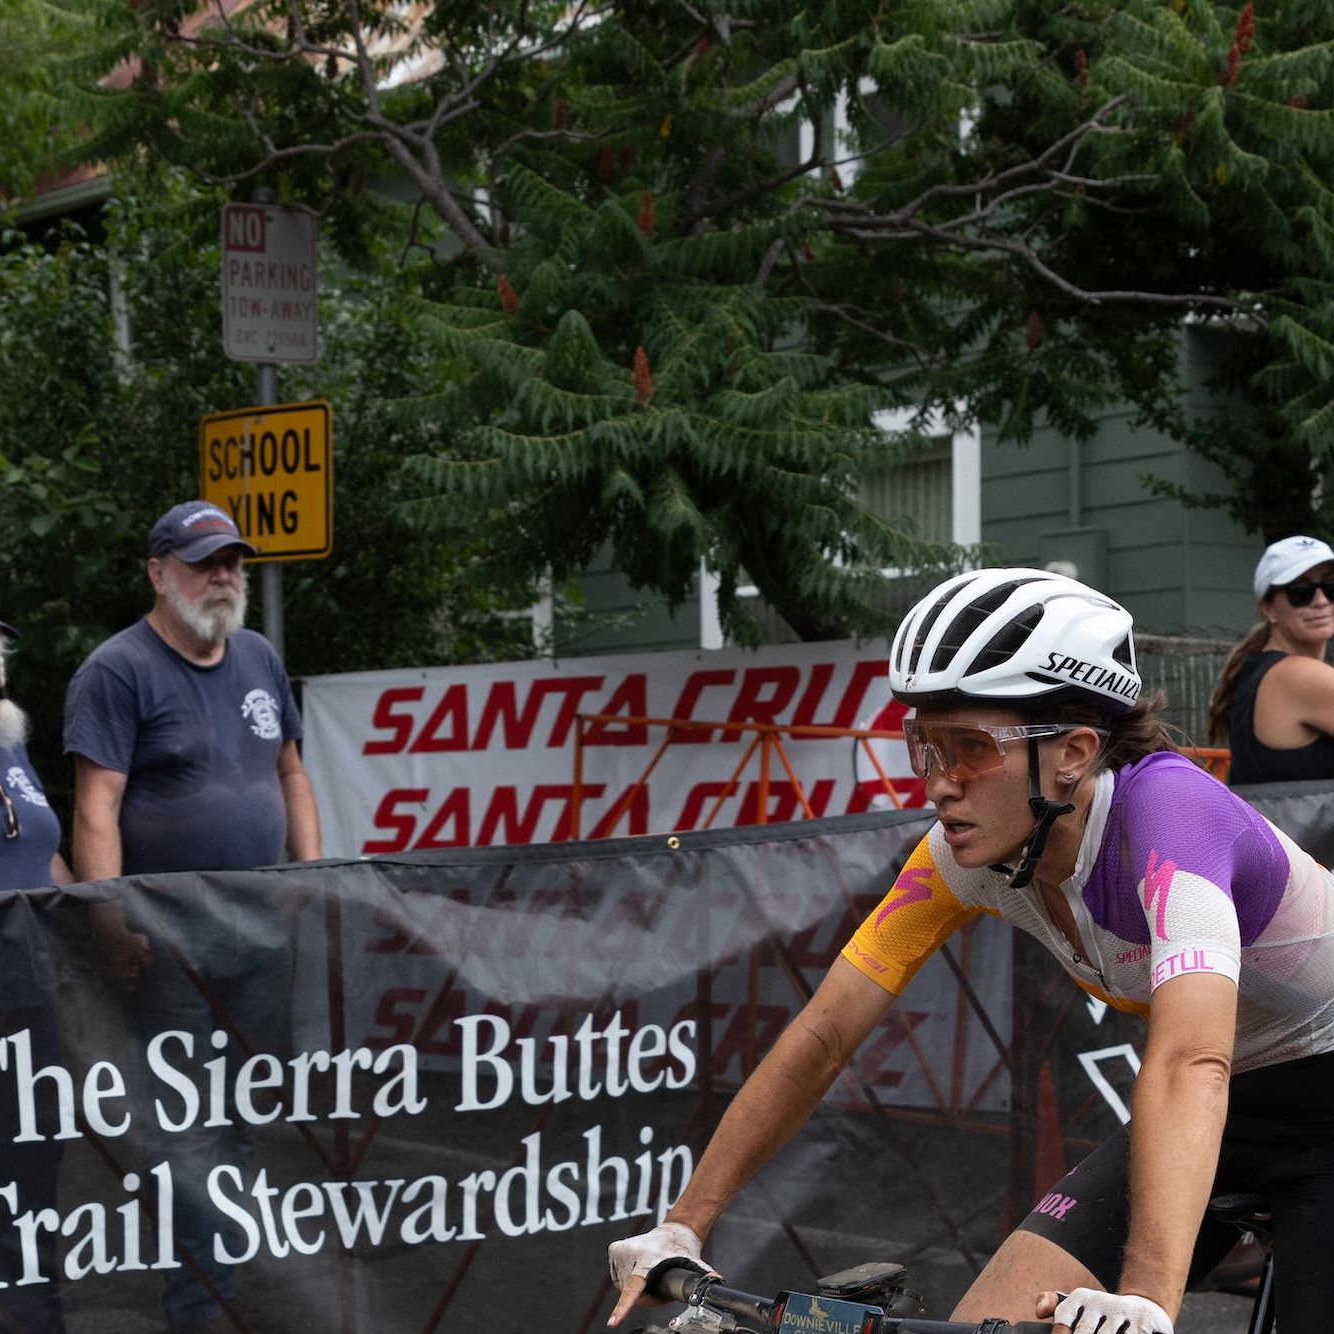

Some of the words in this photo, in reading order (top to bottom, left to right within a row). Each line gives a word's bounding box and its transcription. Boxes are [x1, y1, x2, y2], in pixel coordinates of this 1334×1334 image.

[229, 212, 261, 246] NO
[229, 259, 312, 291] PARKING
[229, 296, 311, 320] TOW-AWAY
[208, 428, 321, 483] SCHOOL
[229, 489, 299, 538] XING
[1038, 651, 1141, 701] SPECIALIZE
[362, 673, 648, 756] SANTA
[361, 783, 650, 855] SANTA
[847, 939, 890, 974] oval
[146, 1029, 428, 1132] Sierra
[453, 1009, 698, 1114] Buttes
[206, 1124, 694, 1266] Stewardship
